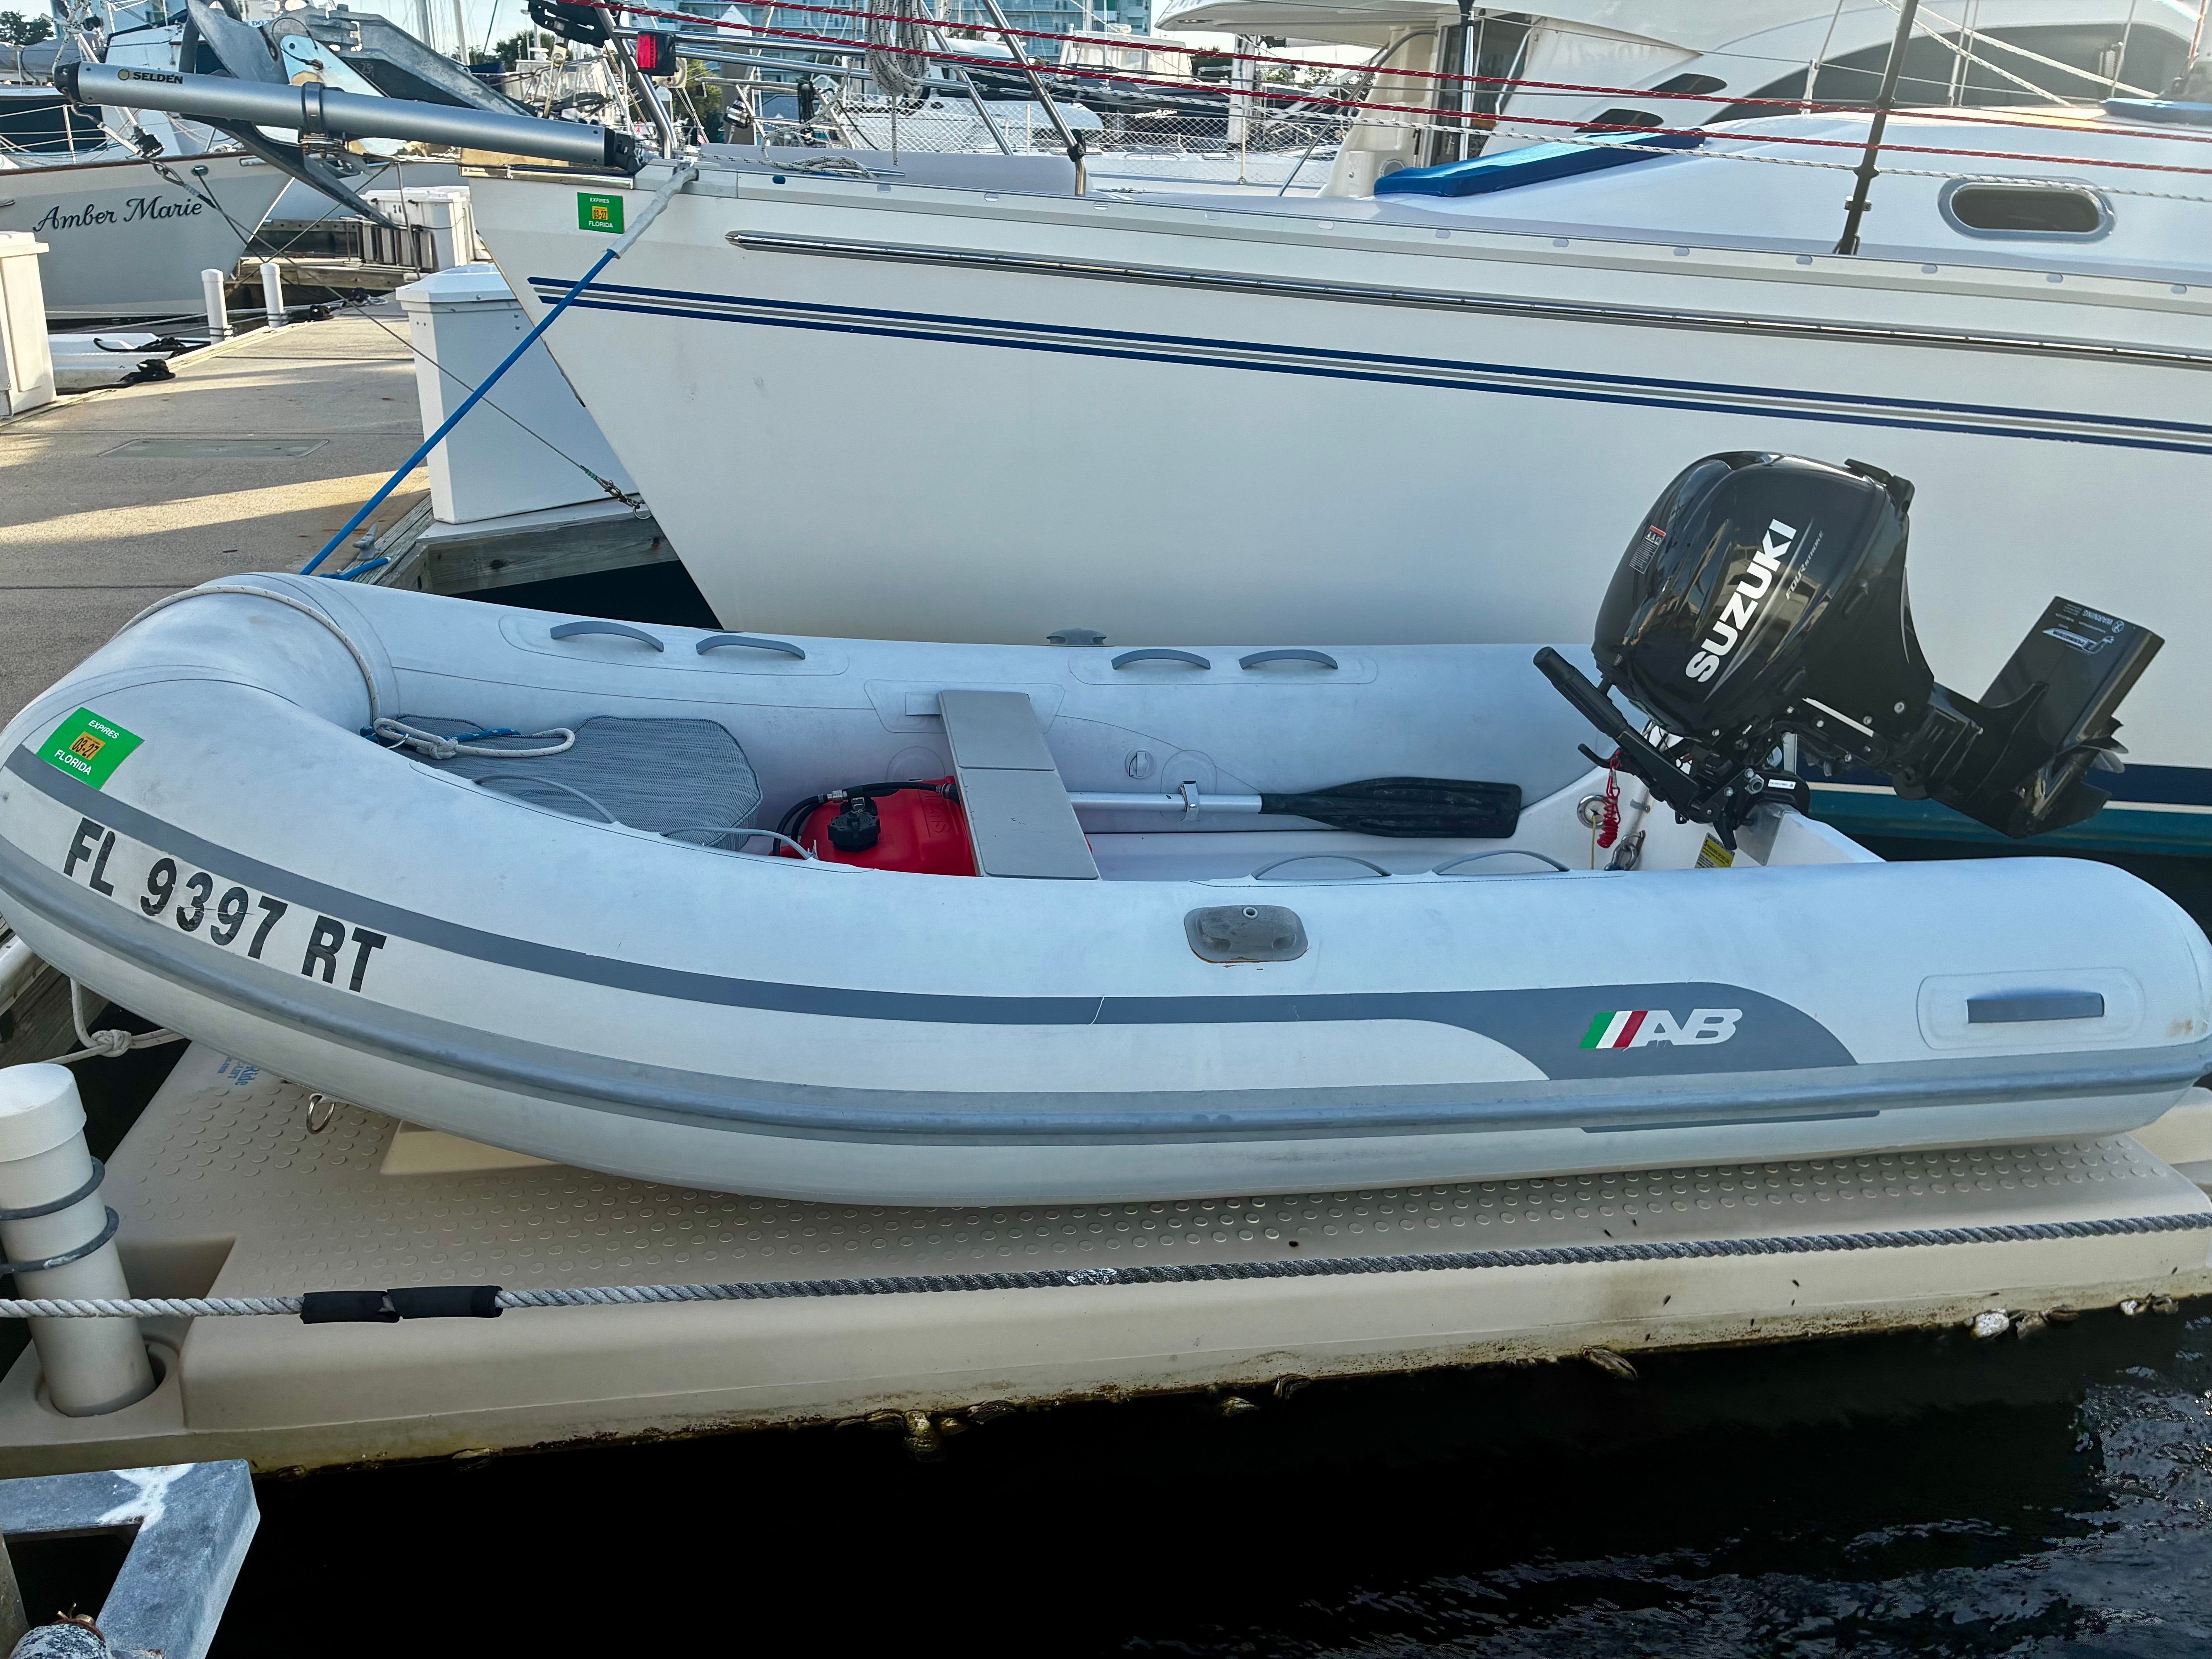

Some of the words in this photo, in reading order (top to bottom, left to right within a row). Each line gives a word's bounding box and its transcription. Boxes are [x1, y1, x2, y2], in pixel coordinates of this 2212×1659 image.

[33, 204, 117, 232] Amber
[124, 196, 202, 222] Marie
[593, 210, 607, 220] 03-27
[1685, 519, 1797, 682] SUZUKI
[88, 720, 120, 739] EXPIRES
[54, 749, 92, 775] FLORIDA
[72, 737, 100, 758] 03-27
[64, 817, 116, 897] FL
[140, 858, 288, 960] 9397
[301, 915, 387, 993] RT
[1626, 1008, 1743, 1046] AB
